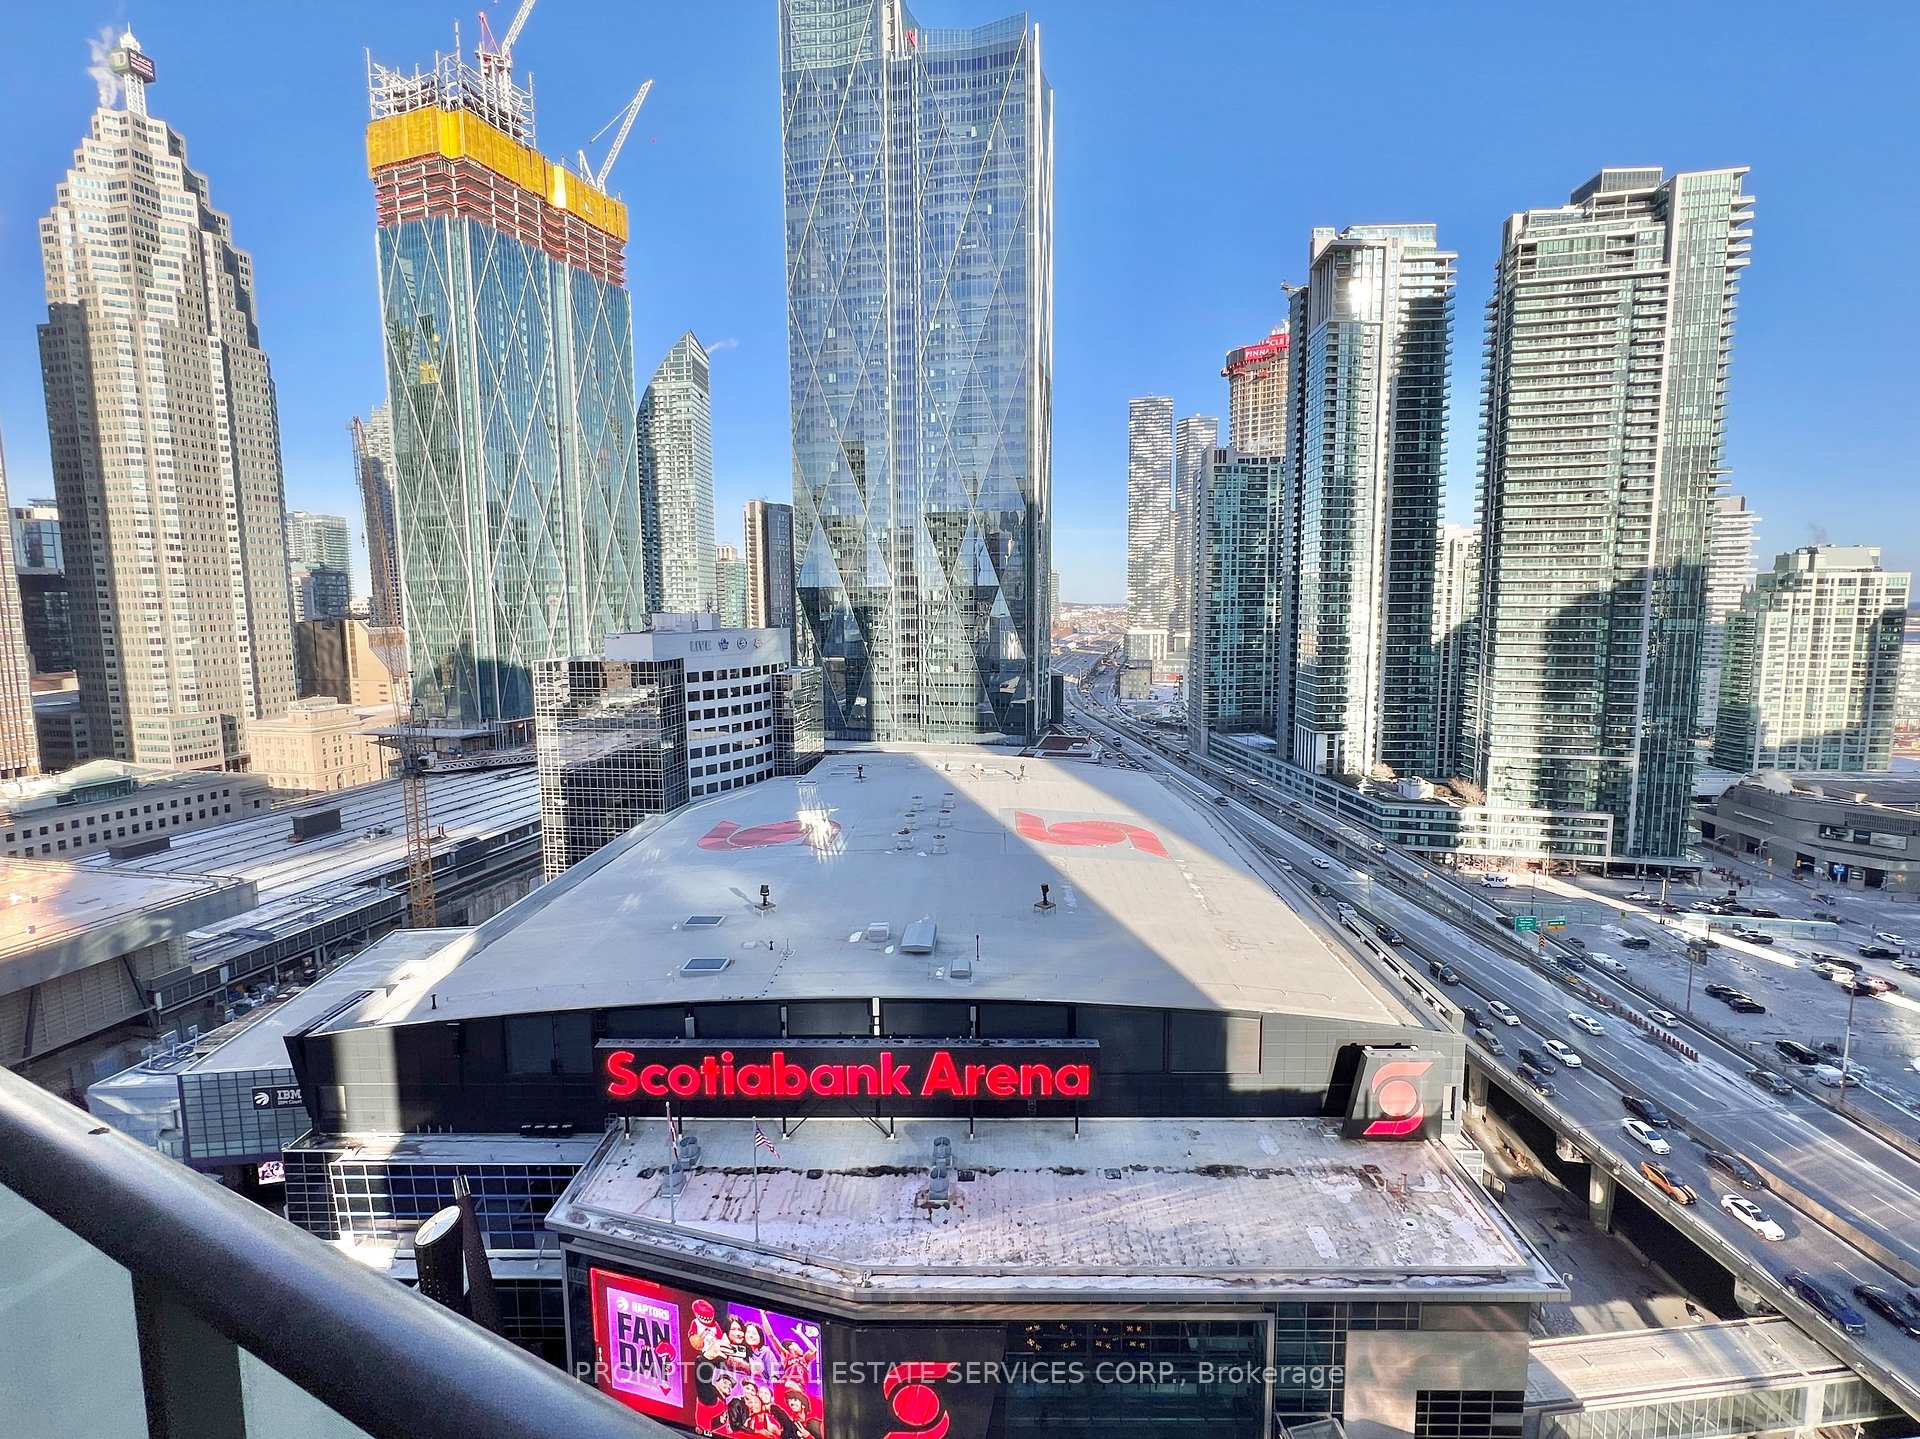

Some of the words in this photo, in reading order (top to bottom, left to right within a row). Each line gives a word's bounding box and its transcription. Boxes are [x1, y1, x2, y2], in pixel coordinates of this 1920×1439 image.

[608, 1051, 911, 1096] Scotiabank
[921, 1051, 1090, 1096] Arena
[277, 1089, 302, 1100] IBM
[632, 1302, 669, 1320] RAPTORS
[618, 1312, 670, 1347] FAN
